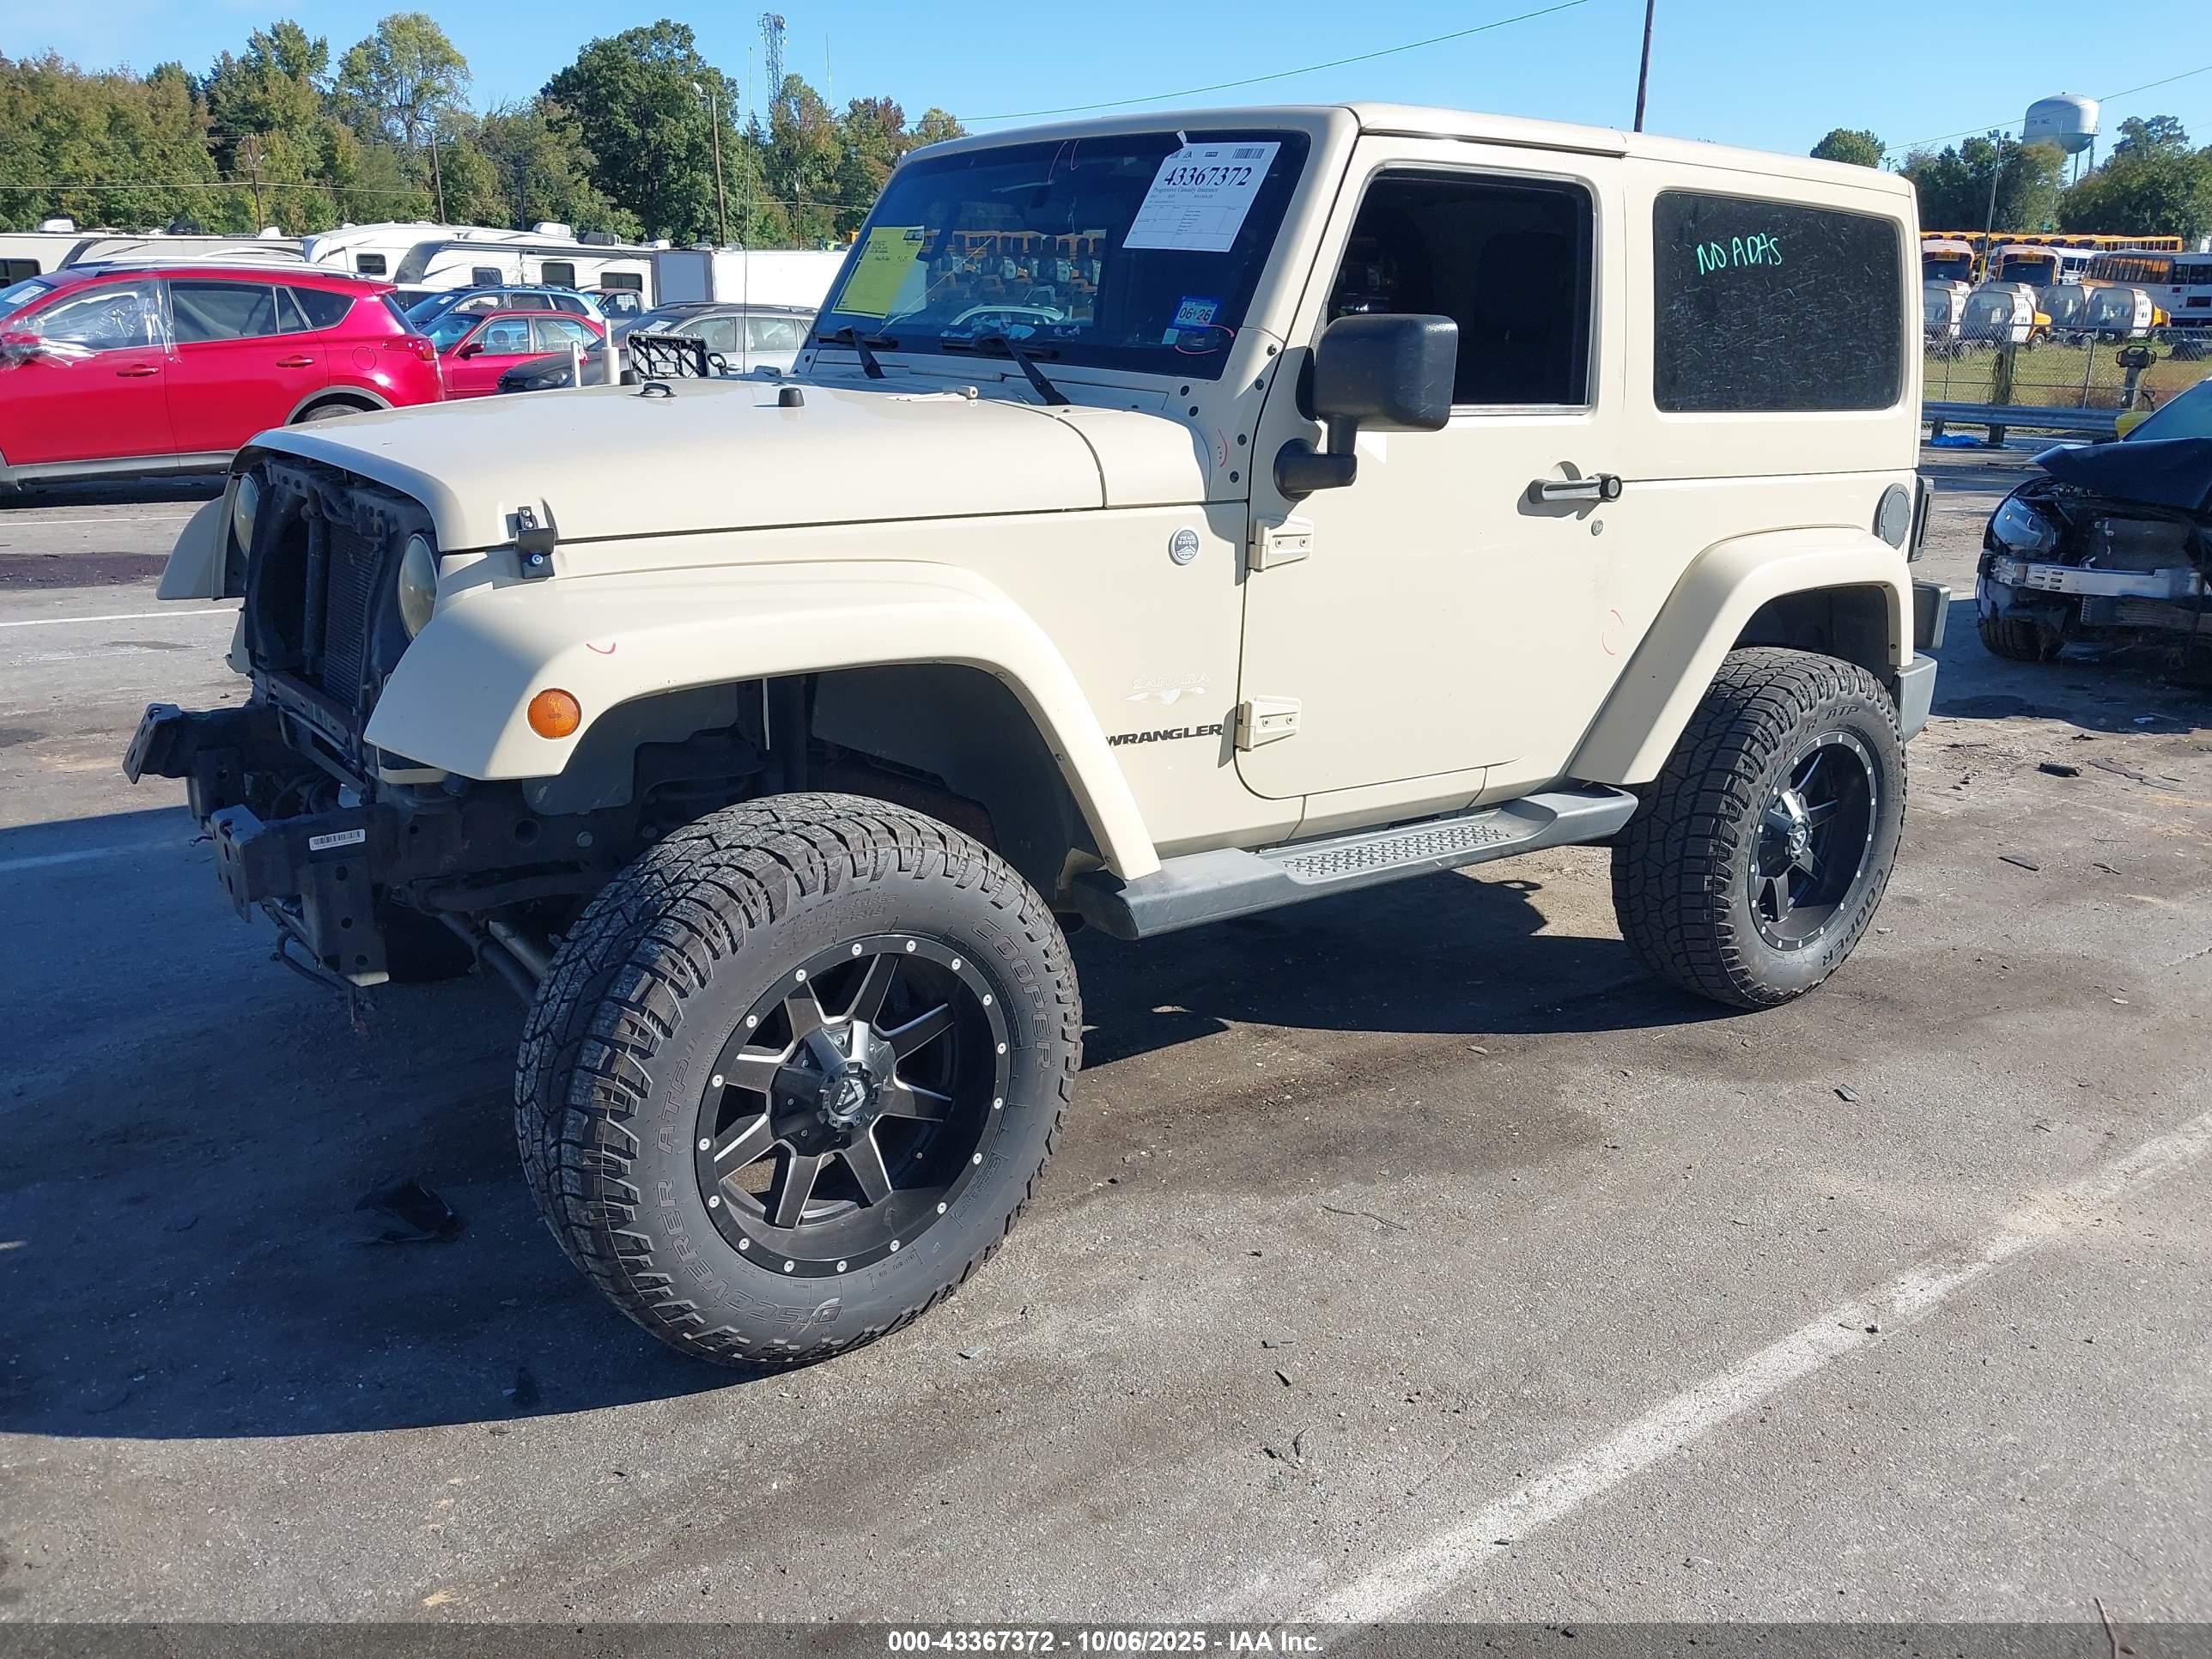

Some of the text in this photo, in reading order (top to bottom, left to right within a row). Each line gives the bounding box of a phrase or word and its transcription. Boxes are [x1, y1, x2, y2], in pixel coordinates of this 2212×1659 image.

[1164, 166, 1252, 185] 43367372
[1696, 233, 1783, 276] NO ADAS
[1179, 307, 1212, 321] 06 26
[1105, 723, 1224, 747] WRANGLER
[1821, 867, 1885, 968] COOPER
[970, 917, 1053, 1070] COOPER
[656, 1179, 844, 1327] DISCOVERER
